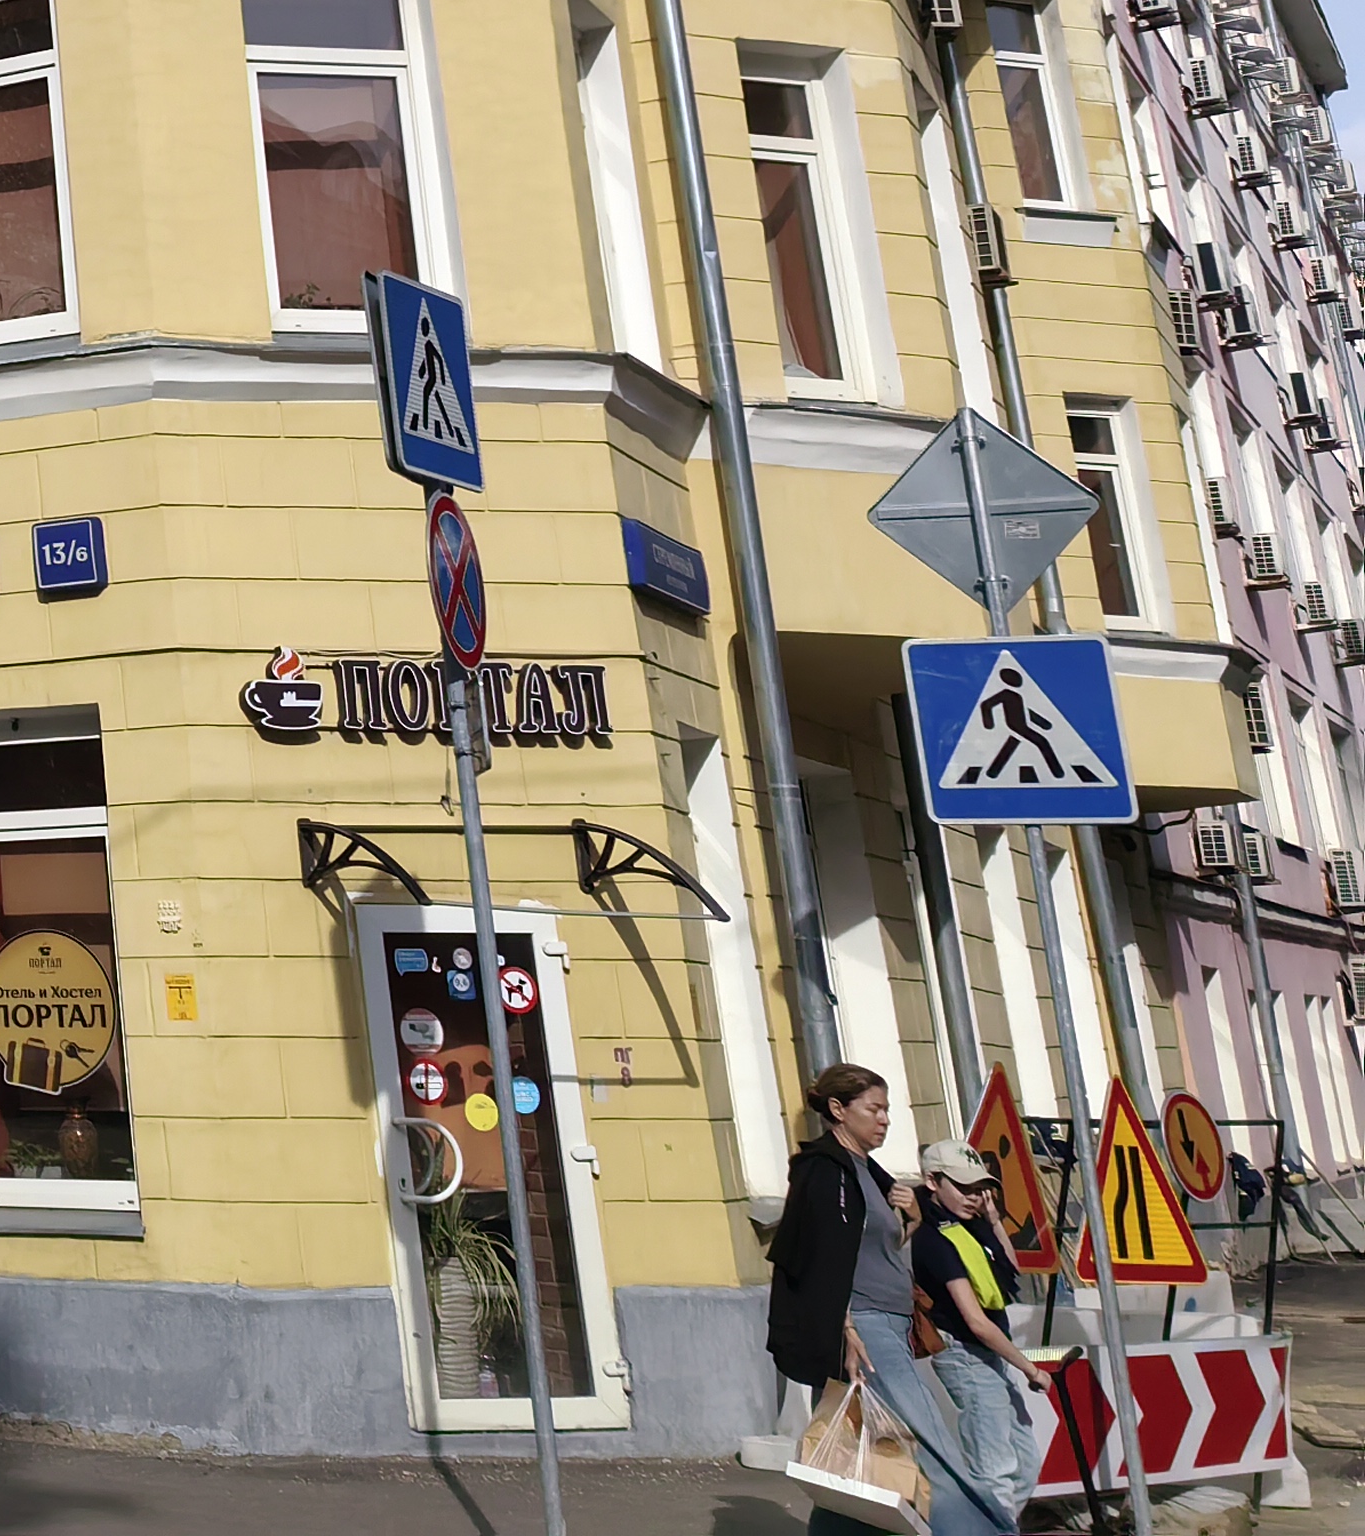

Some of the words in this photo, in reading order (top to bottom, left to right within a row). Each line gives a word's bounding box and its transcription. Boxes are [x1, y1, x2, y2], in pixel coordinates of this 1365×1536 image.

[41, 539, 89, 566] 13/6
[39, 988, 47, 998] и
[50, 985, 102, 999] Хостел
[620, 1066, 632, 1088] 8
